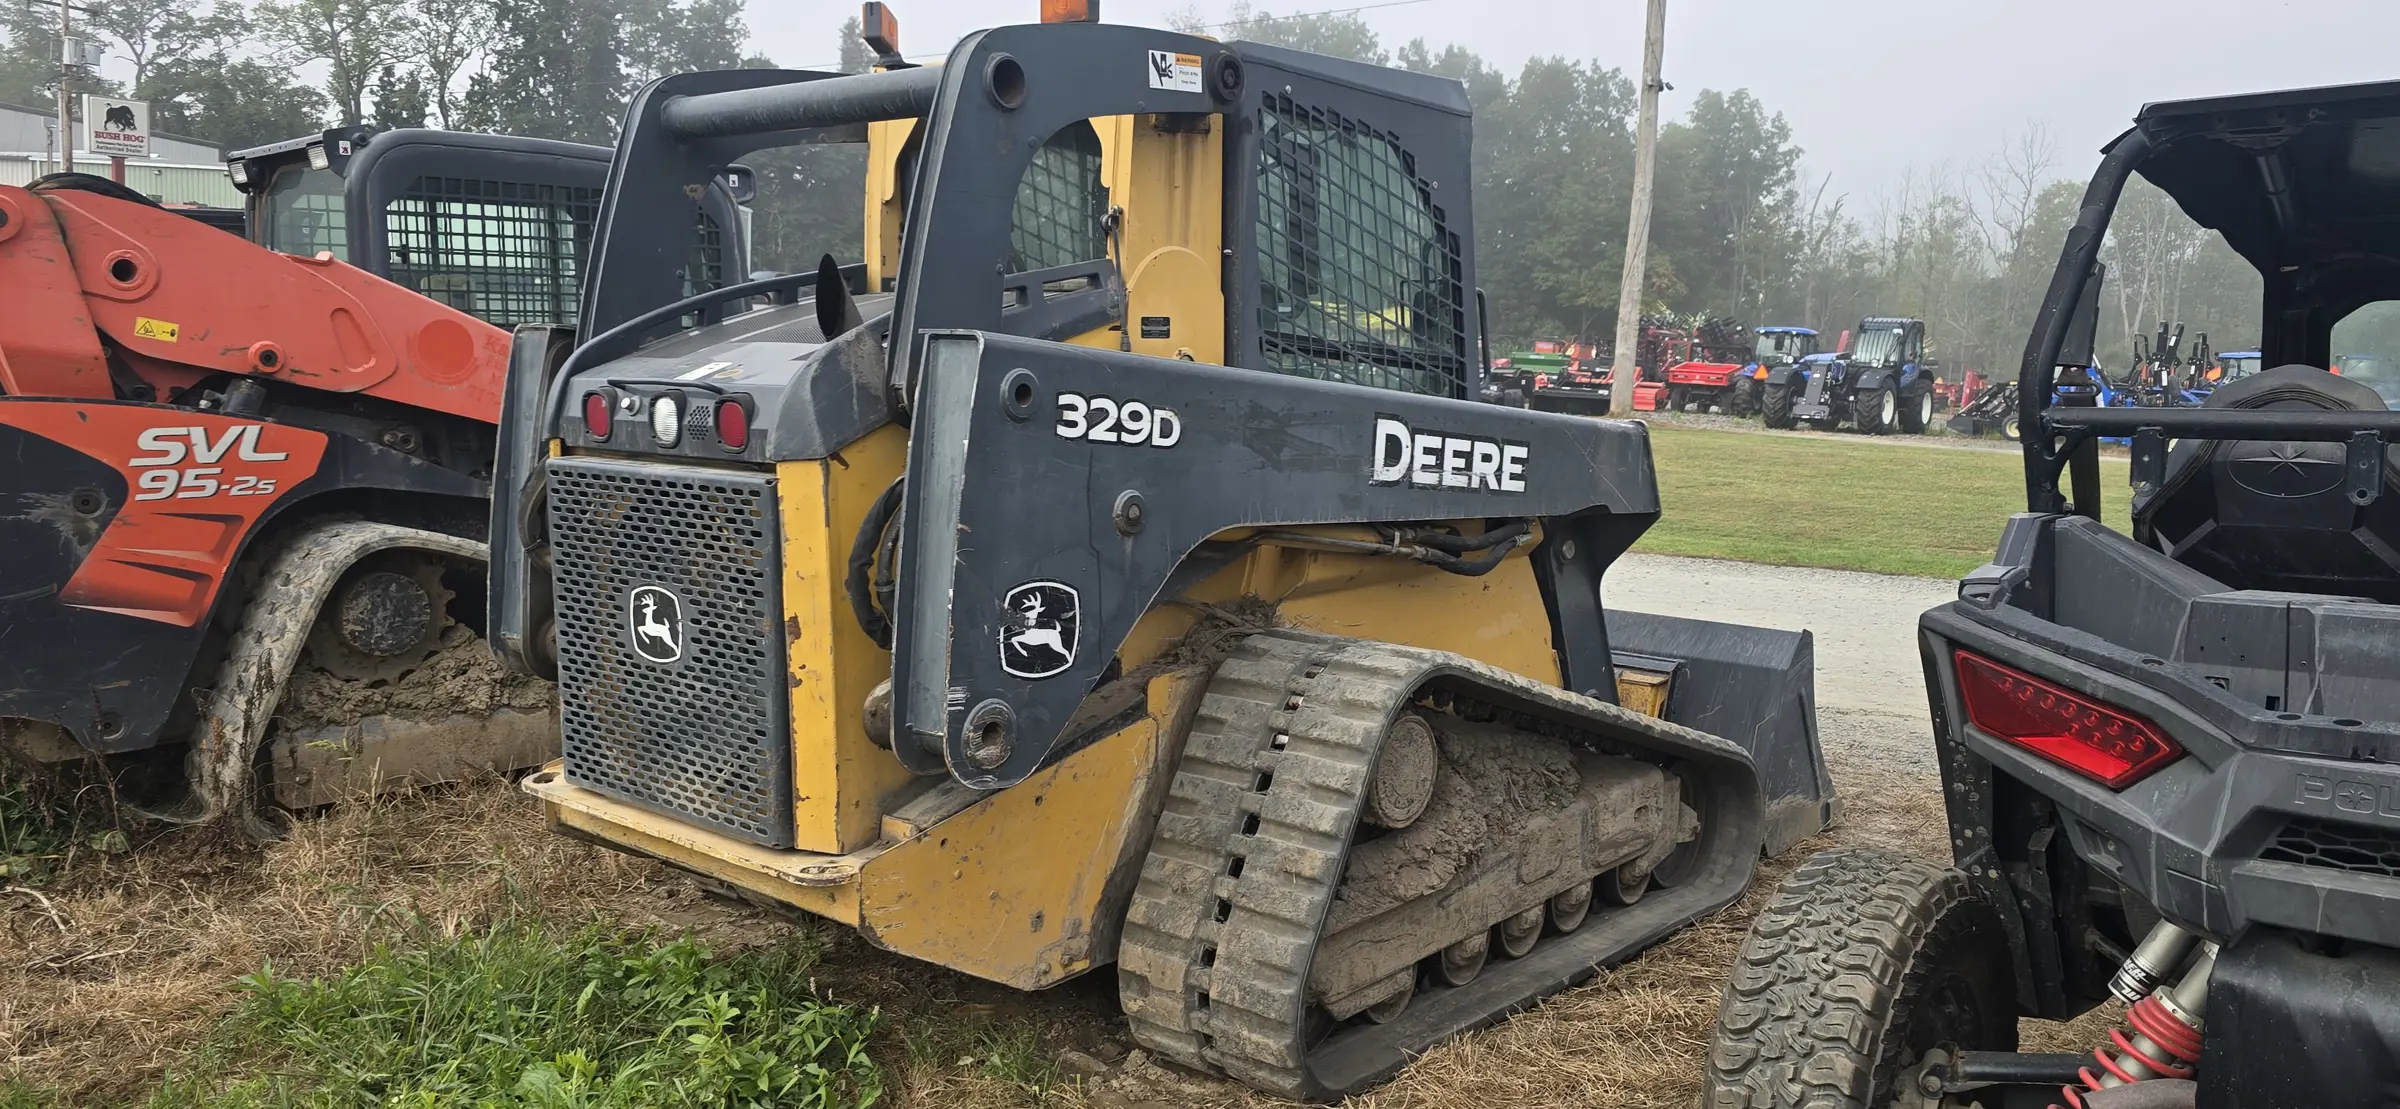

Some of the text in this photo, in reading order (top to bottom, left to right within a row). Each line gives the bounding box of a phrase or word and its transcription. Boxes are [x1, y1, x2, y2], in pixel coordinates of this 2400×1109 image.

[94, 131, 145, 143] BUSH HOG
[1056, 393, 1181, 447] 329D
[128, 425, 289, 467] SVL
[1373, 418, 1529, 493] DEERE
